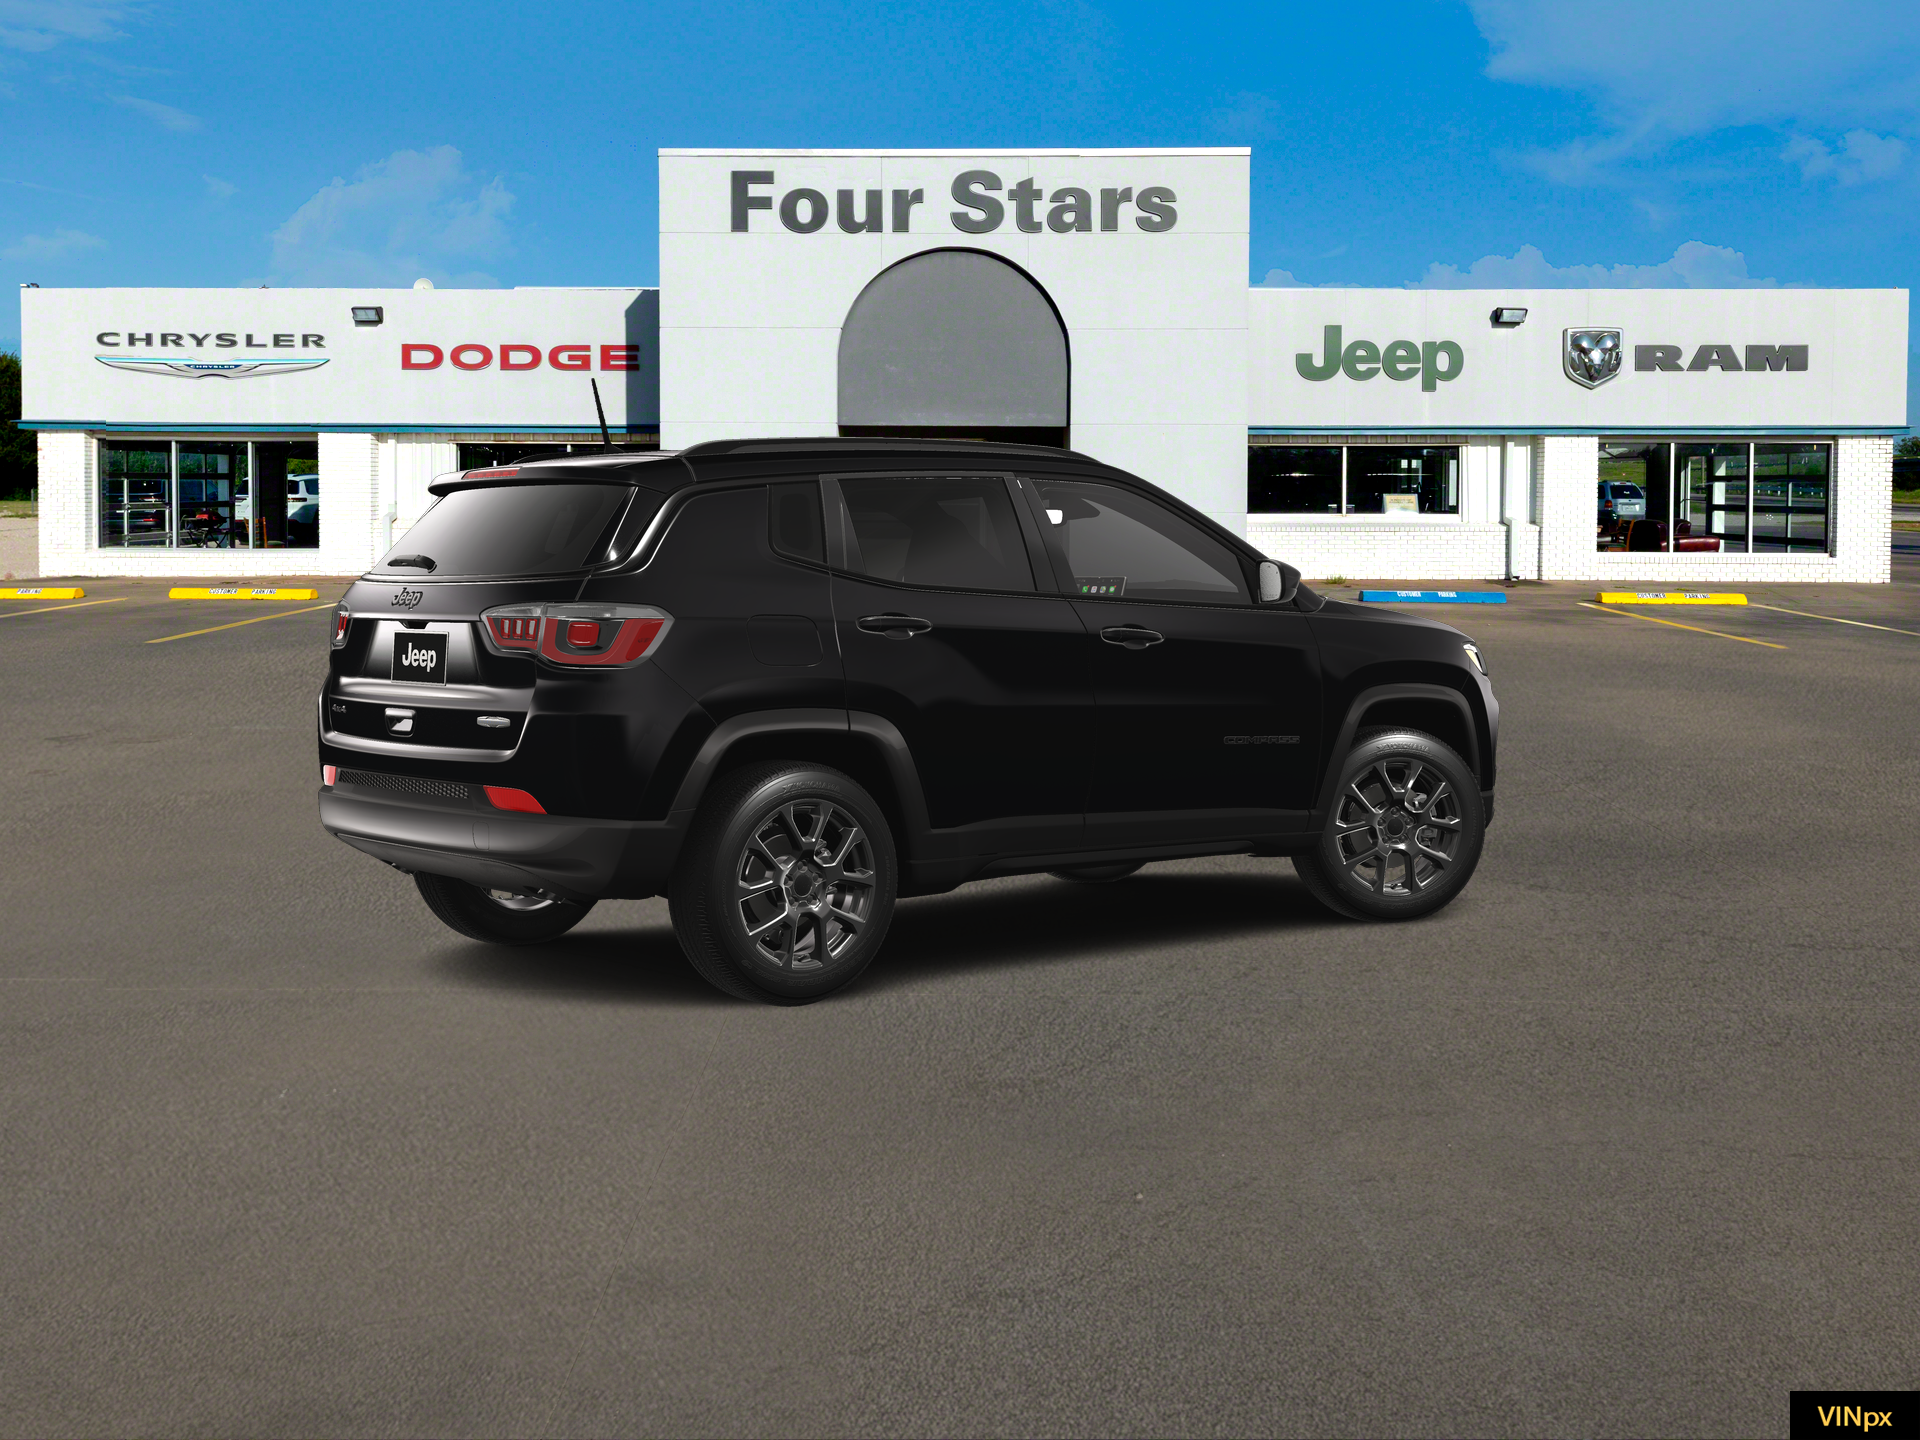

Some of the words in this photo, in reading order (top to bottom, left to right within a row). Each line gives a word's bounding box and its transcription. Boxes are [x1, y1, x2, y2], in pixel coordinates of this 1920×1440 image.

[730, 170, 924, 235] Four
[949, 170, 1178, 235] Stars
[96, 332, 326, 349] CHRYSLER
[401, 343, 641, 371] DODGE
[1296, 324, 1464, 391] Jeep
[1634, 344, 1808, 371] RAM
[391, 587, 424, 610] Jeep
[402, 642, 437, 673] Jeep
[332, 703, 347, 713] 4x4
[1223, 735, 1301, 745] COMPASS
